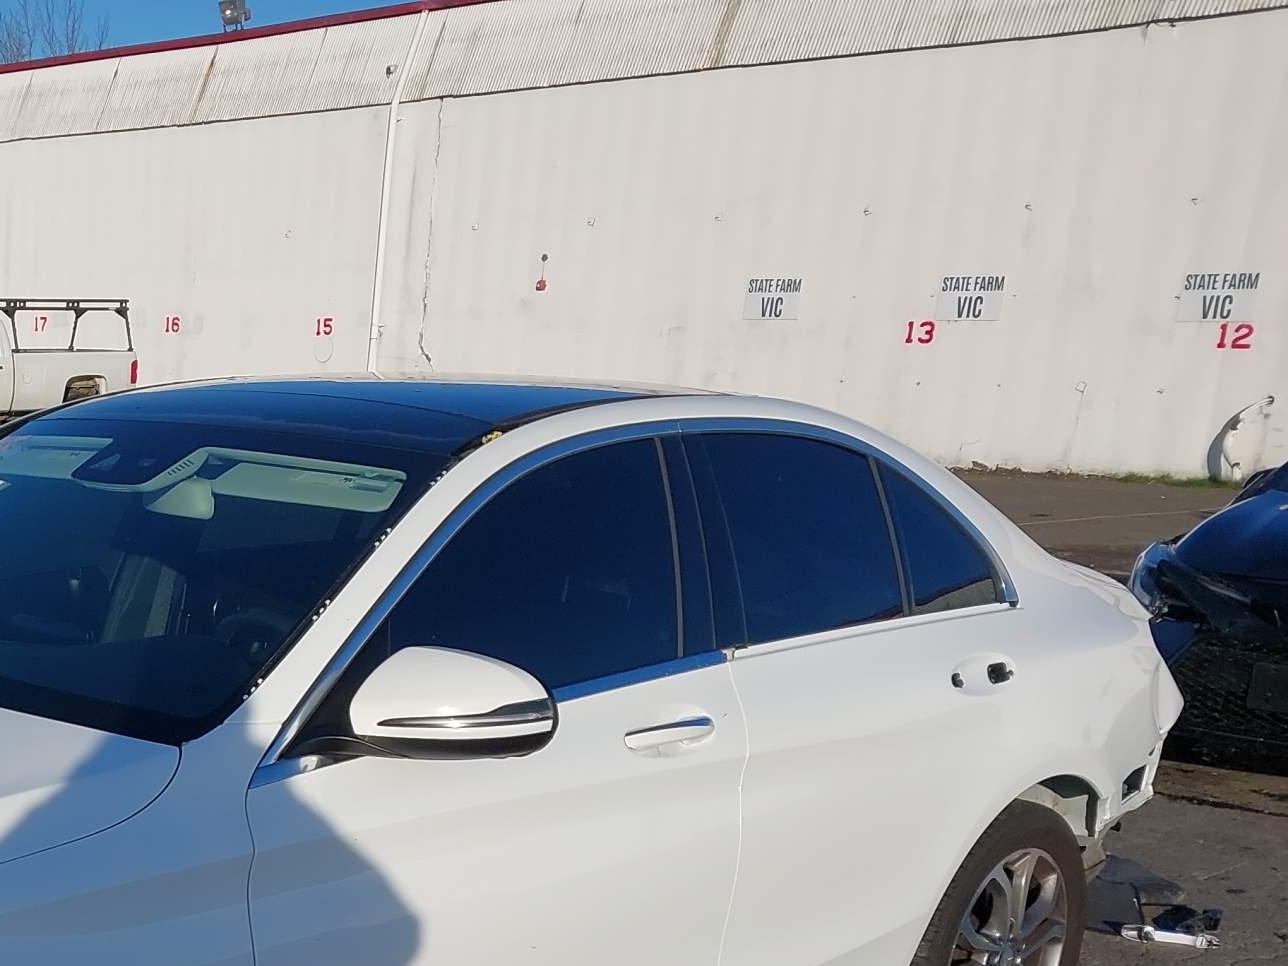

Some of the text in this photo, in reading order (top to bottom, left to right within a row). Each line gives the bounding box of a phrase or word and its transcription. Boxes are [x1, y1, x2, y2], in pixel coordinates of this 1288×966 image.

[748, 278, 803, 293] STATE FARM
[941, 275, 1006, 293] STATE FARM
[1184, 272, 1261, 291] STATE FARM
[760, 296, 784, 318] VIC
[955, 295, 984, 319] VIC
[1201, 294, 1234, 320] VIC
[33, 316, 48, 332] 17
[164, 316, 181, 333] 16
[314, 318, 333, 337] 15
[904, 320, 936, 344] 13
[1216, 323, 1255, 350] 12
